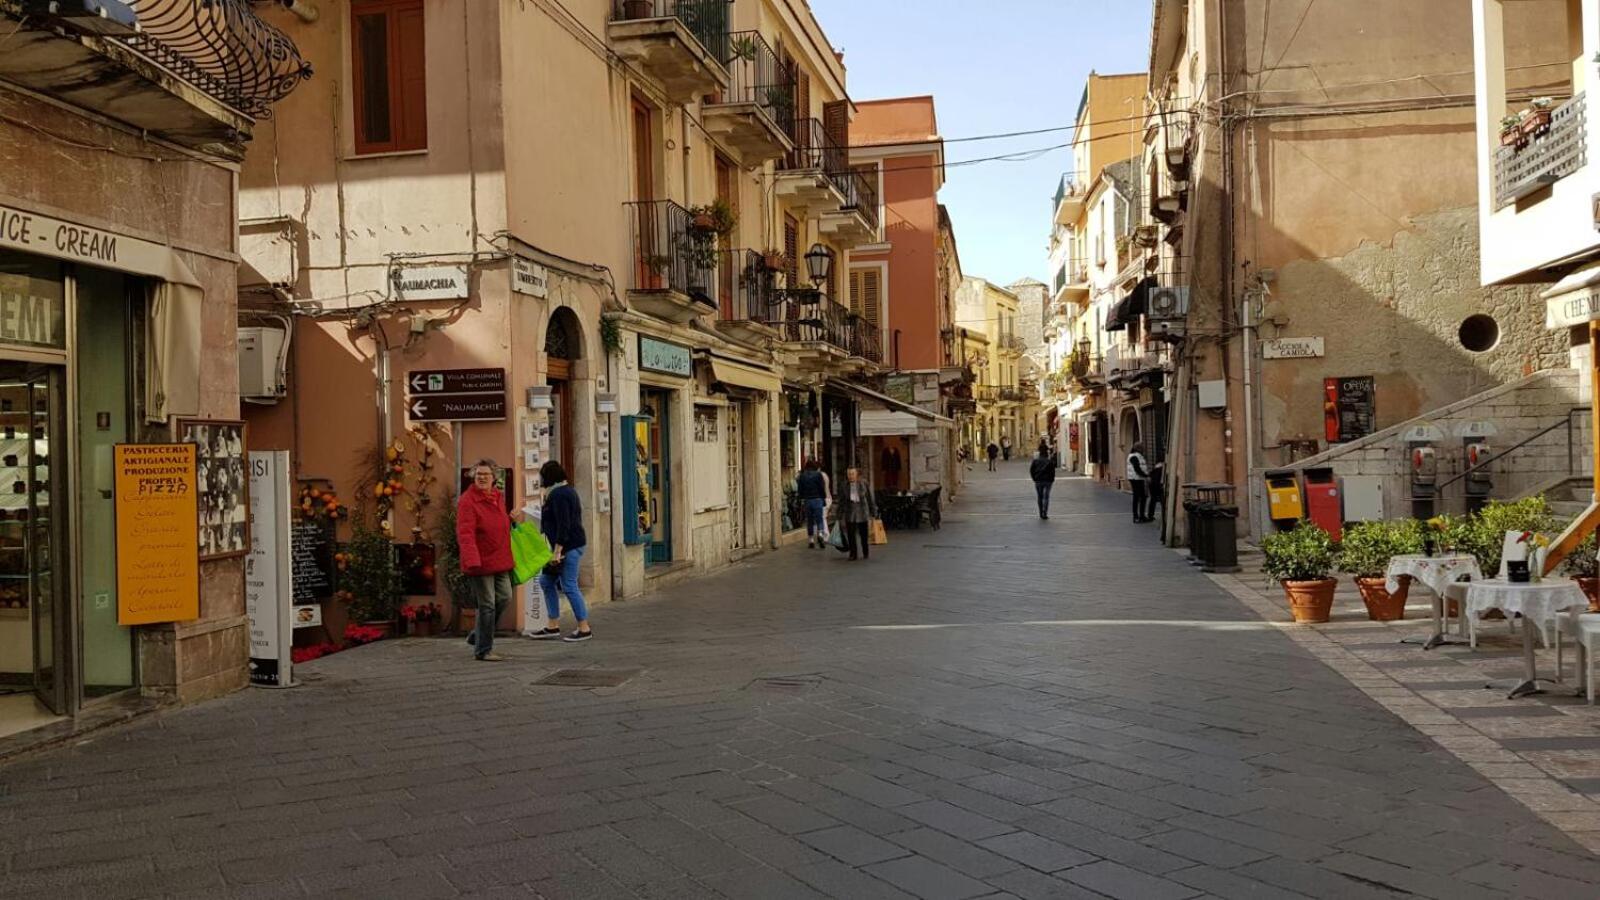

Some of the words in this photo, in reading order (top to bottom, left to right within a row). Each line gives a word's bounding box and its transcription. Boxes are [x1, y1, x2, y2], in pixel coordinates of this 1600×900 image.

[0, 211, 32, 244] ICE
[55, 225, 117, 262] CREAM
[393, 278, 457, 291] NAUMACHIA
[123, 456, 190, 465] ARTIGIANALE
[125, 466, 189, 475] PRODUZIONE
[138, 477, 184, 485] PROPRIA
[138, 483, 188, 495] PIZZA
